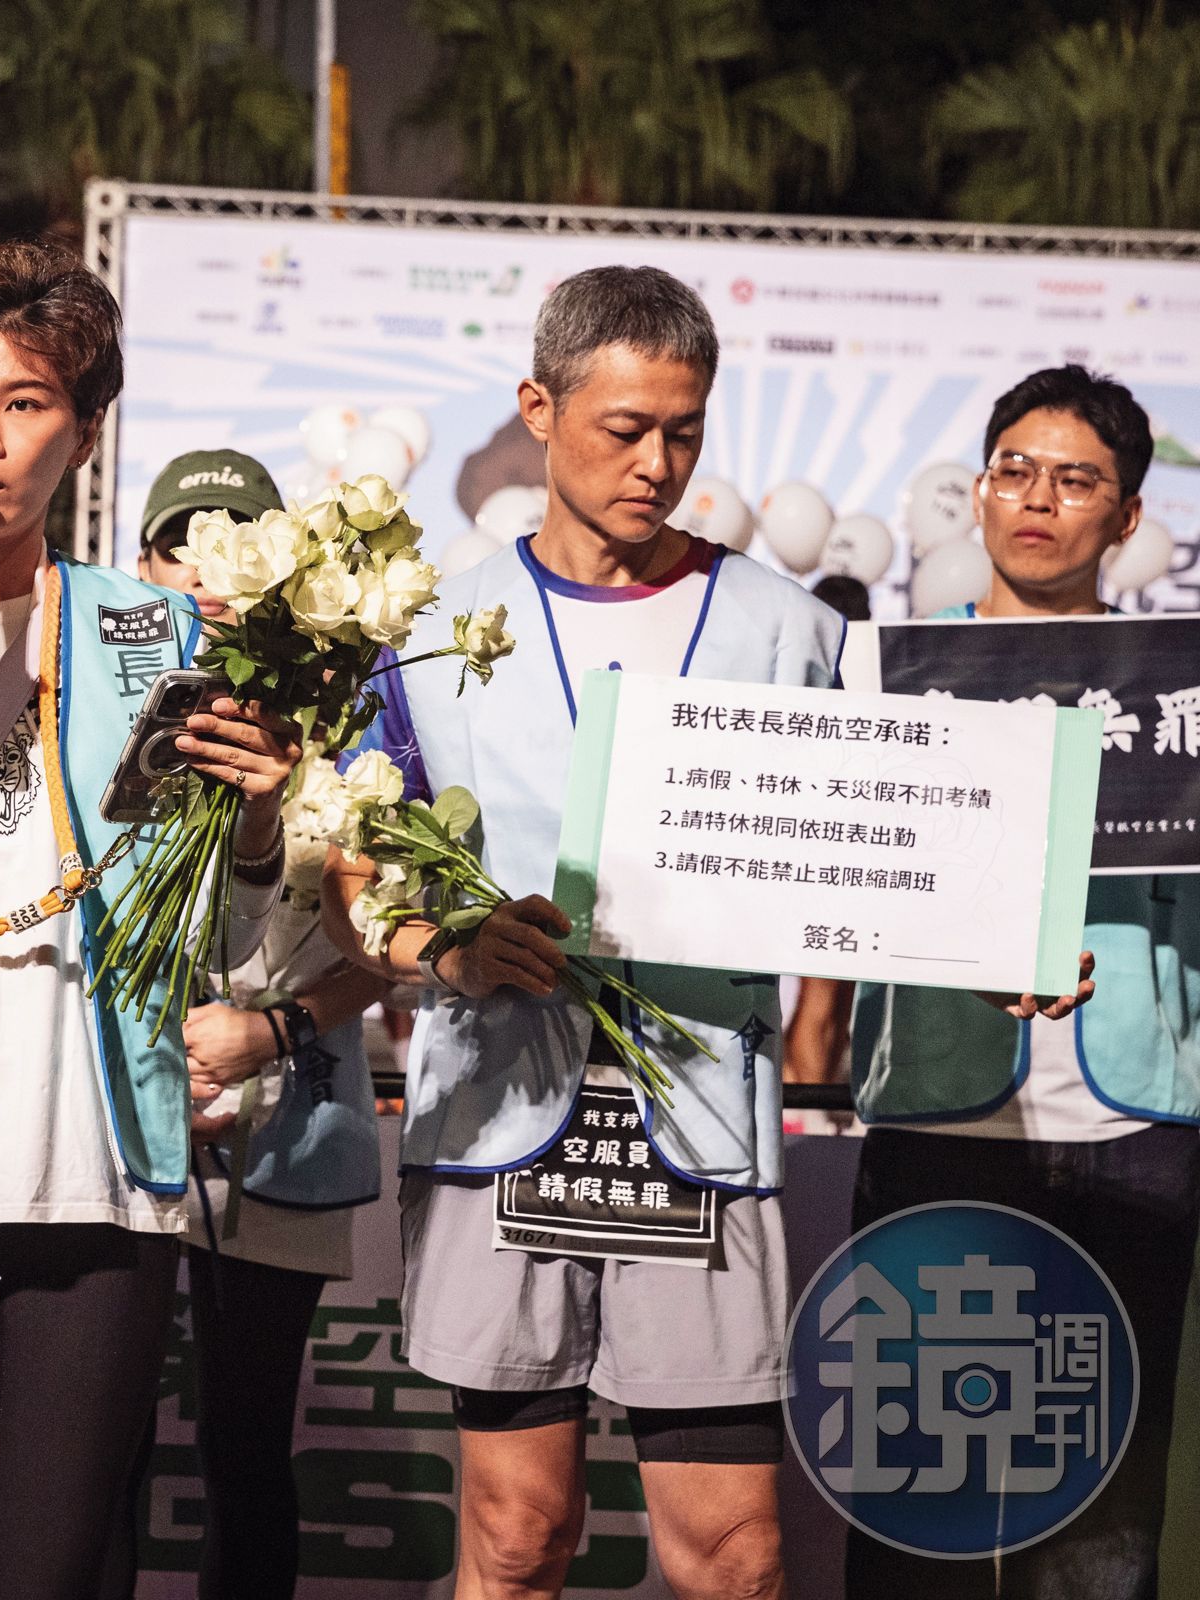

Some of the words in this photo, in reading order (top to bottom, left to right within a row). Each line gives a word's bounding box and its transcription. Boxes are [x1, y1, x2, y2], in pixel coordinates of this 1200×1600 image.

[178, 466, 245, 490] emis
[671, 701, 952, 747] 我代表長榮航空承諾：
[663, 766, 992, 810] 1.病假、特休、天災假不扣考績
[658, 808, 917, 849] 2.請特休視同依班表出勤
[653, 850, 937, 893] 3.請假不能禁止或限縮調班
[583, 1109, 640, 1129] 我支持
[563, 1137, 651, 1169] 空服員
[538, 1172, 671, 1210] 請假無罪
